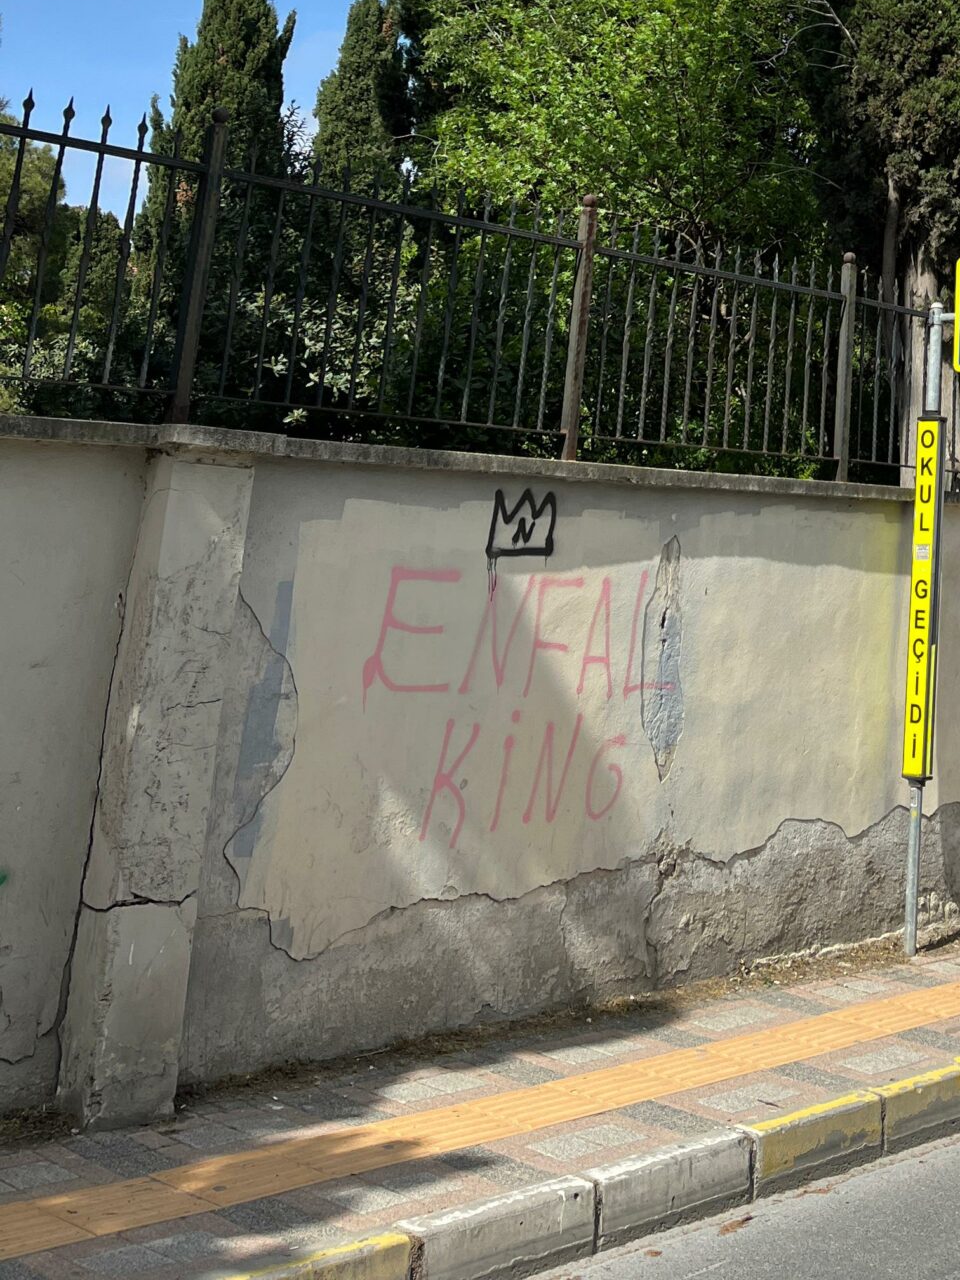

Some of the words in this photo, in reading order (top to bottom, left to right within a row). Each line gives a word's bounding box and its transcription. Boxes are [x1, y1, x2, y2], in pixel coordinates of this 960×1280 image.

[919, 429, 936, 532] OKUL
[362, 565, 676, 704] ENFAL
[909, 579, 928, 759] GEÇİDİ
